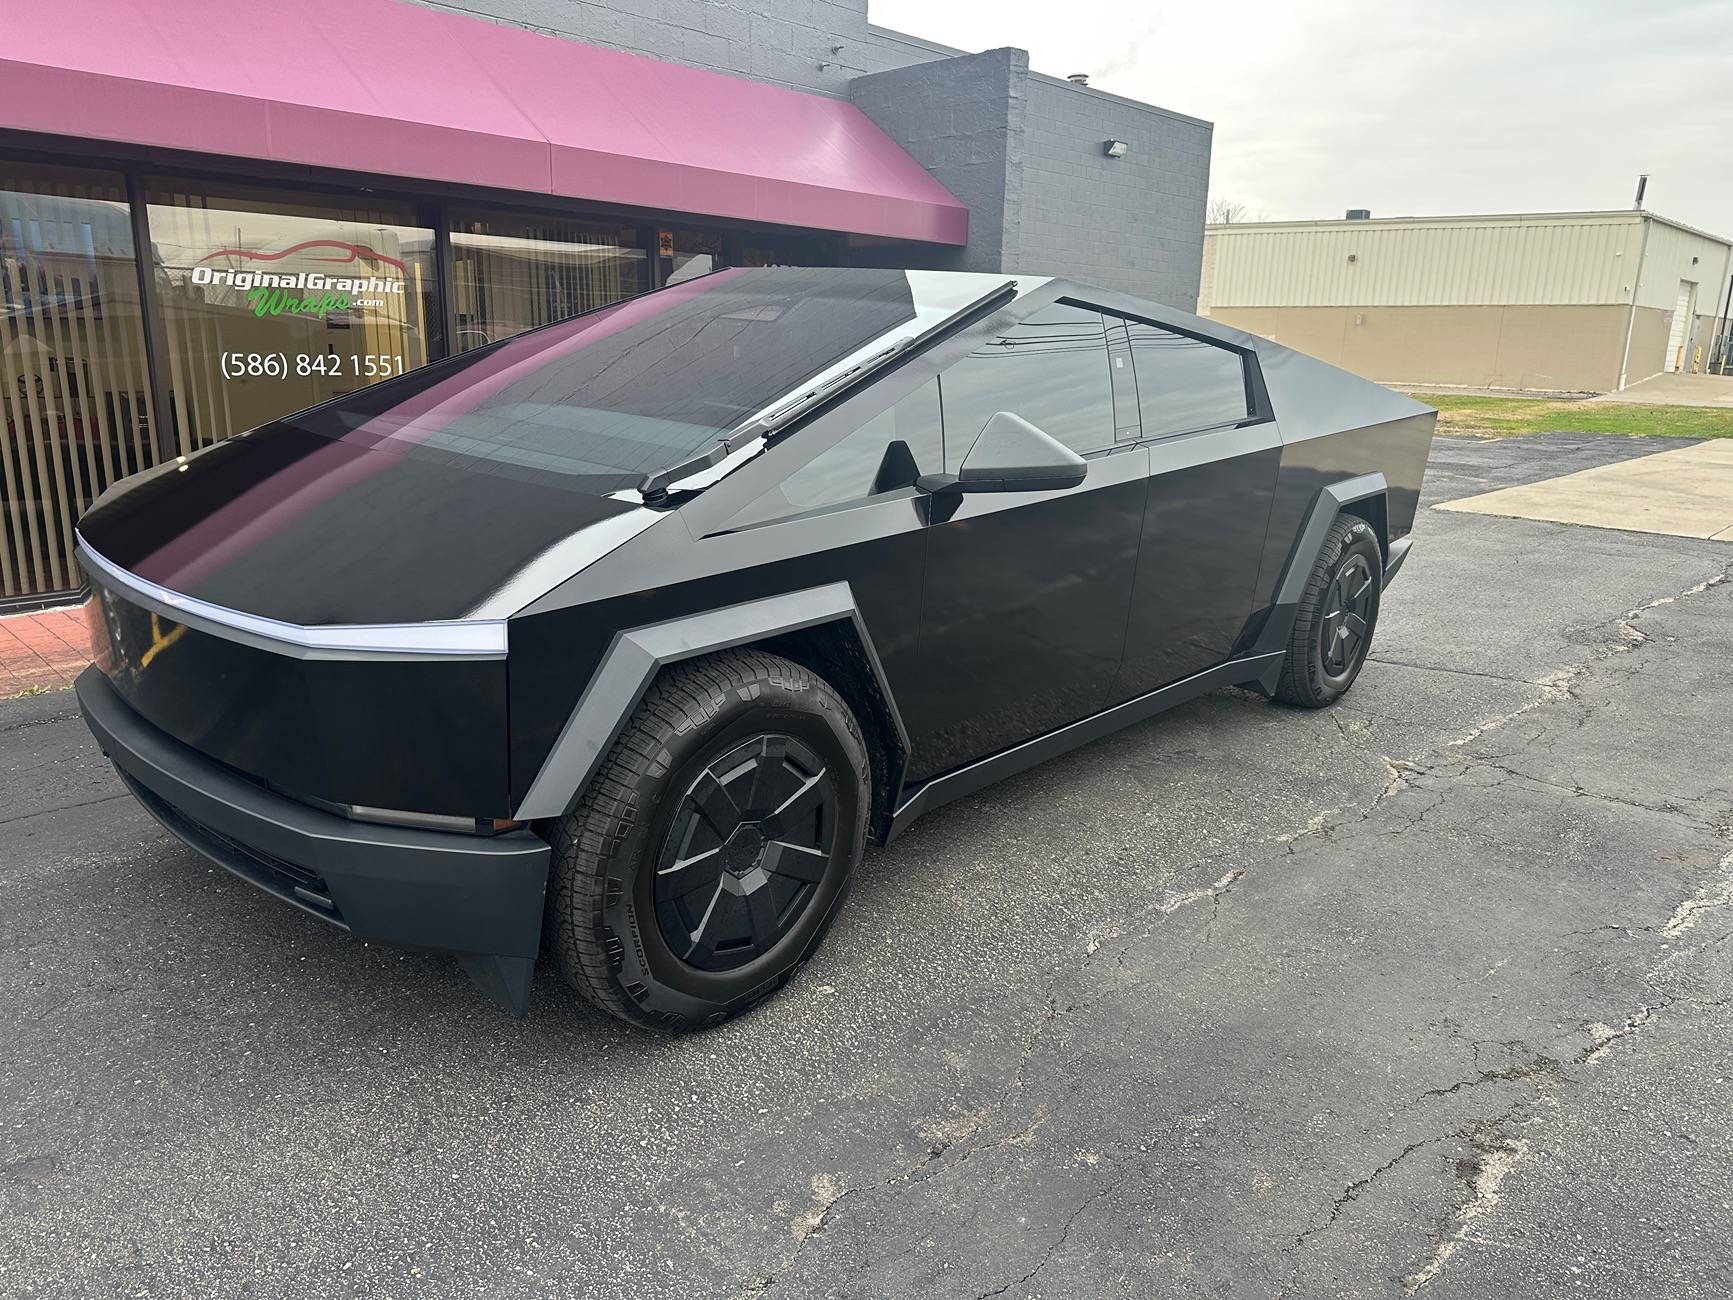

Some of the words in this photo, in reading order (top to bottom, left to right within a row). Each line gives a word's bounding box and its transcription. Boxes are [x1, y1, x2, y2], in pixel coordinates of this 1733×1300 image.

[191, 267, 405, 294] OriginalGraphic
[247, 289, 350, 318] Wraps
[352, 299, 384, 308] .com
[221, 352, 288, 379] (586)
[295, 354, 342, 376] 842
[350, 354, 403, 377] 1551
[626, 903, 649, 976] SCORPION
